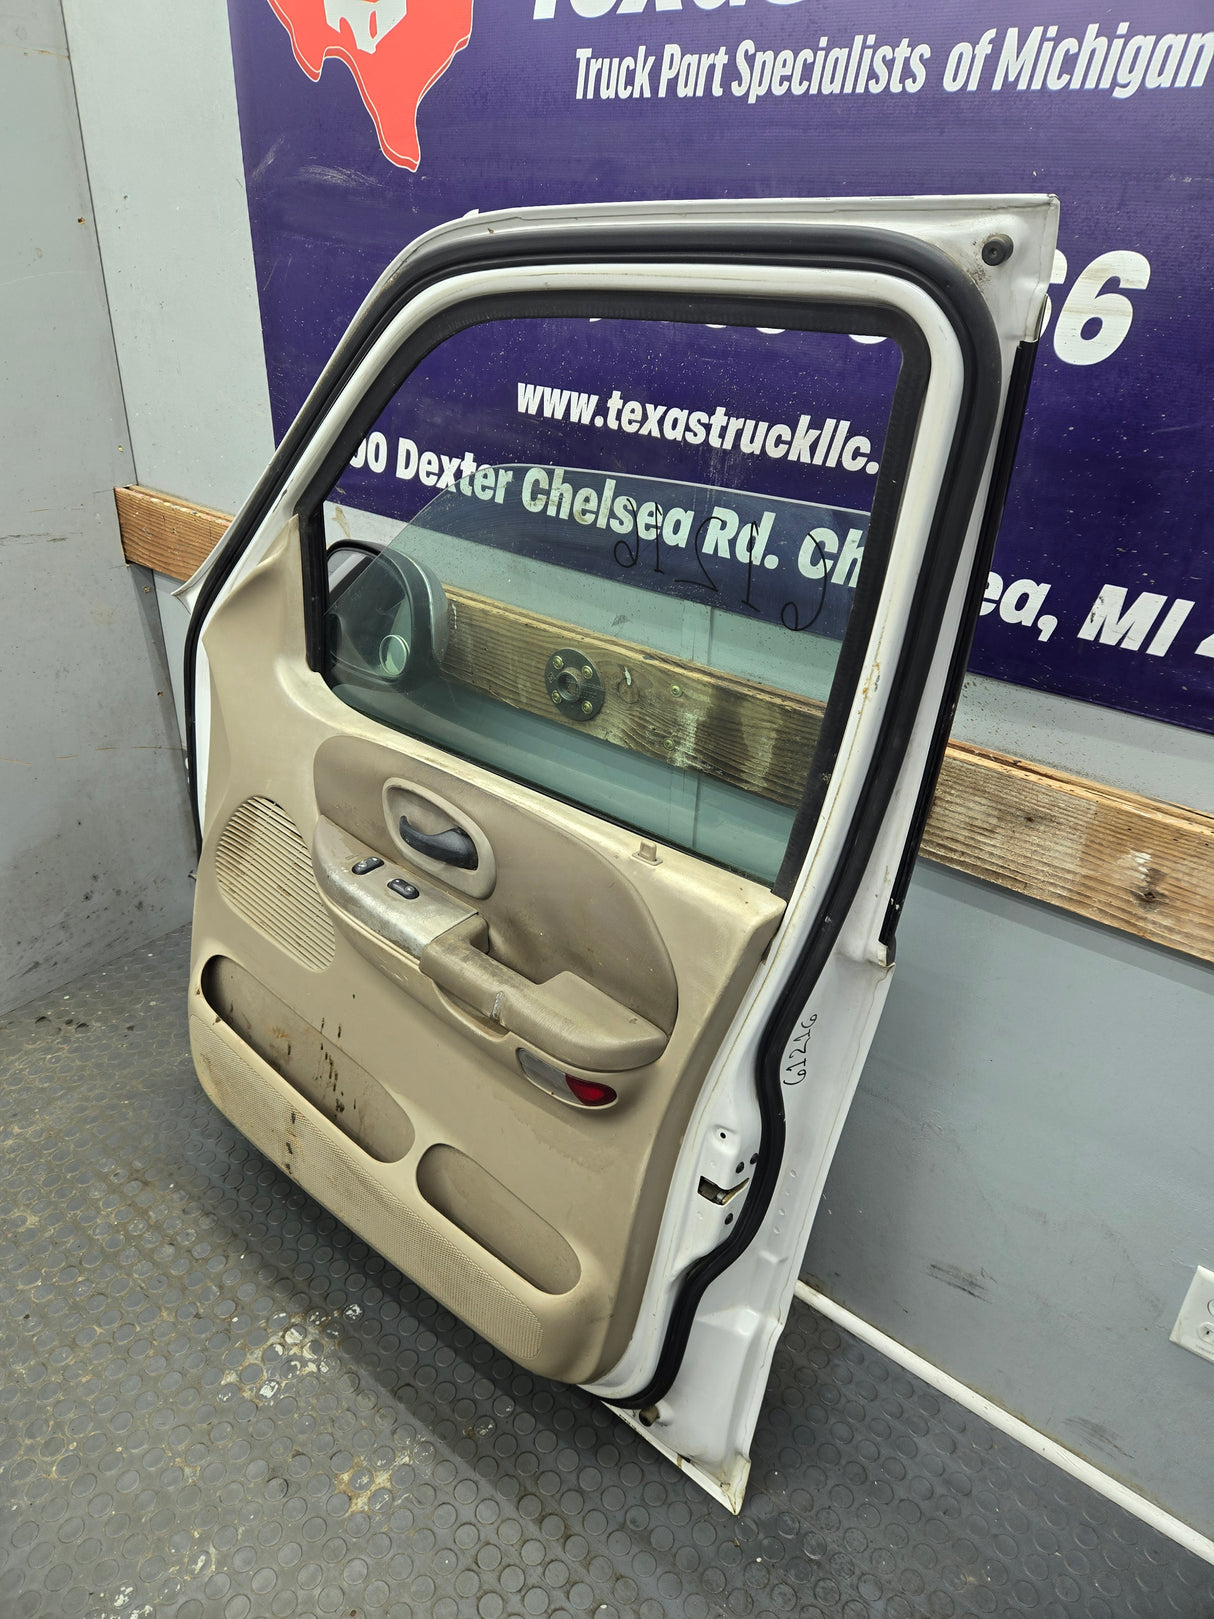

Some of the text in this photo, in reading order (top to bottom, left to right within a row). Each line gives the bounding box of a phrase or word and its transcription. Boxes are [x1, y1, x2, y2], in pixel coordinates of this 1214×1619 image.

[576, 22, 1214, 104] Truck Part Specialists of Michigan
[517, 382, 880, 475] www.texastruckllc.
[396, 437, 513, 504] Dexter
[521, 467, 695, 548] Chelsea
[702, 506, 780, 570] Rd.
[1077, 583, 1196, 657] MI
[783, 1013, 818, 1086] 61216
